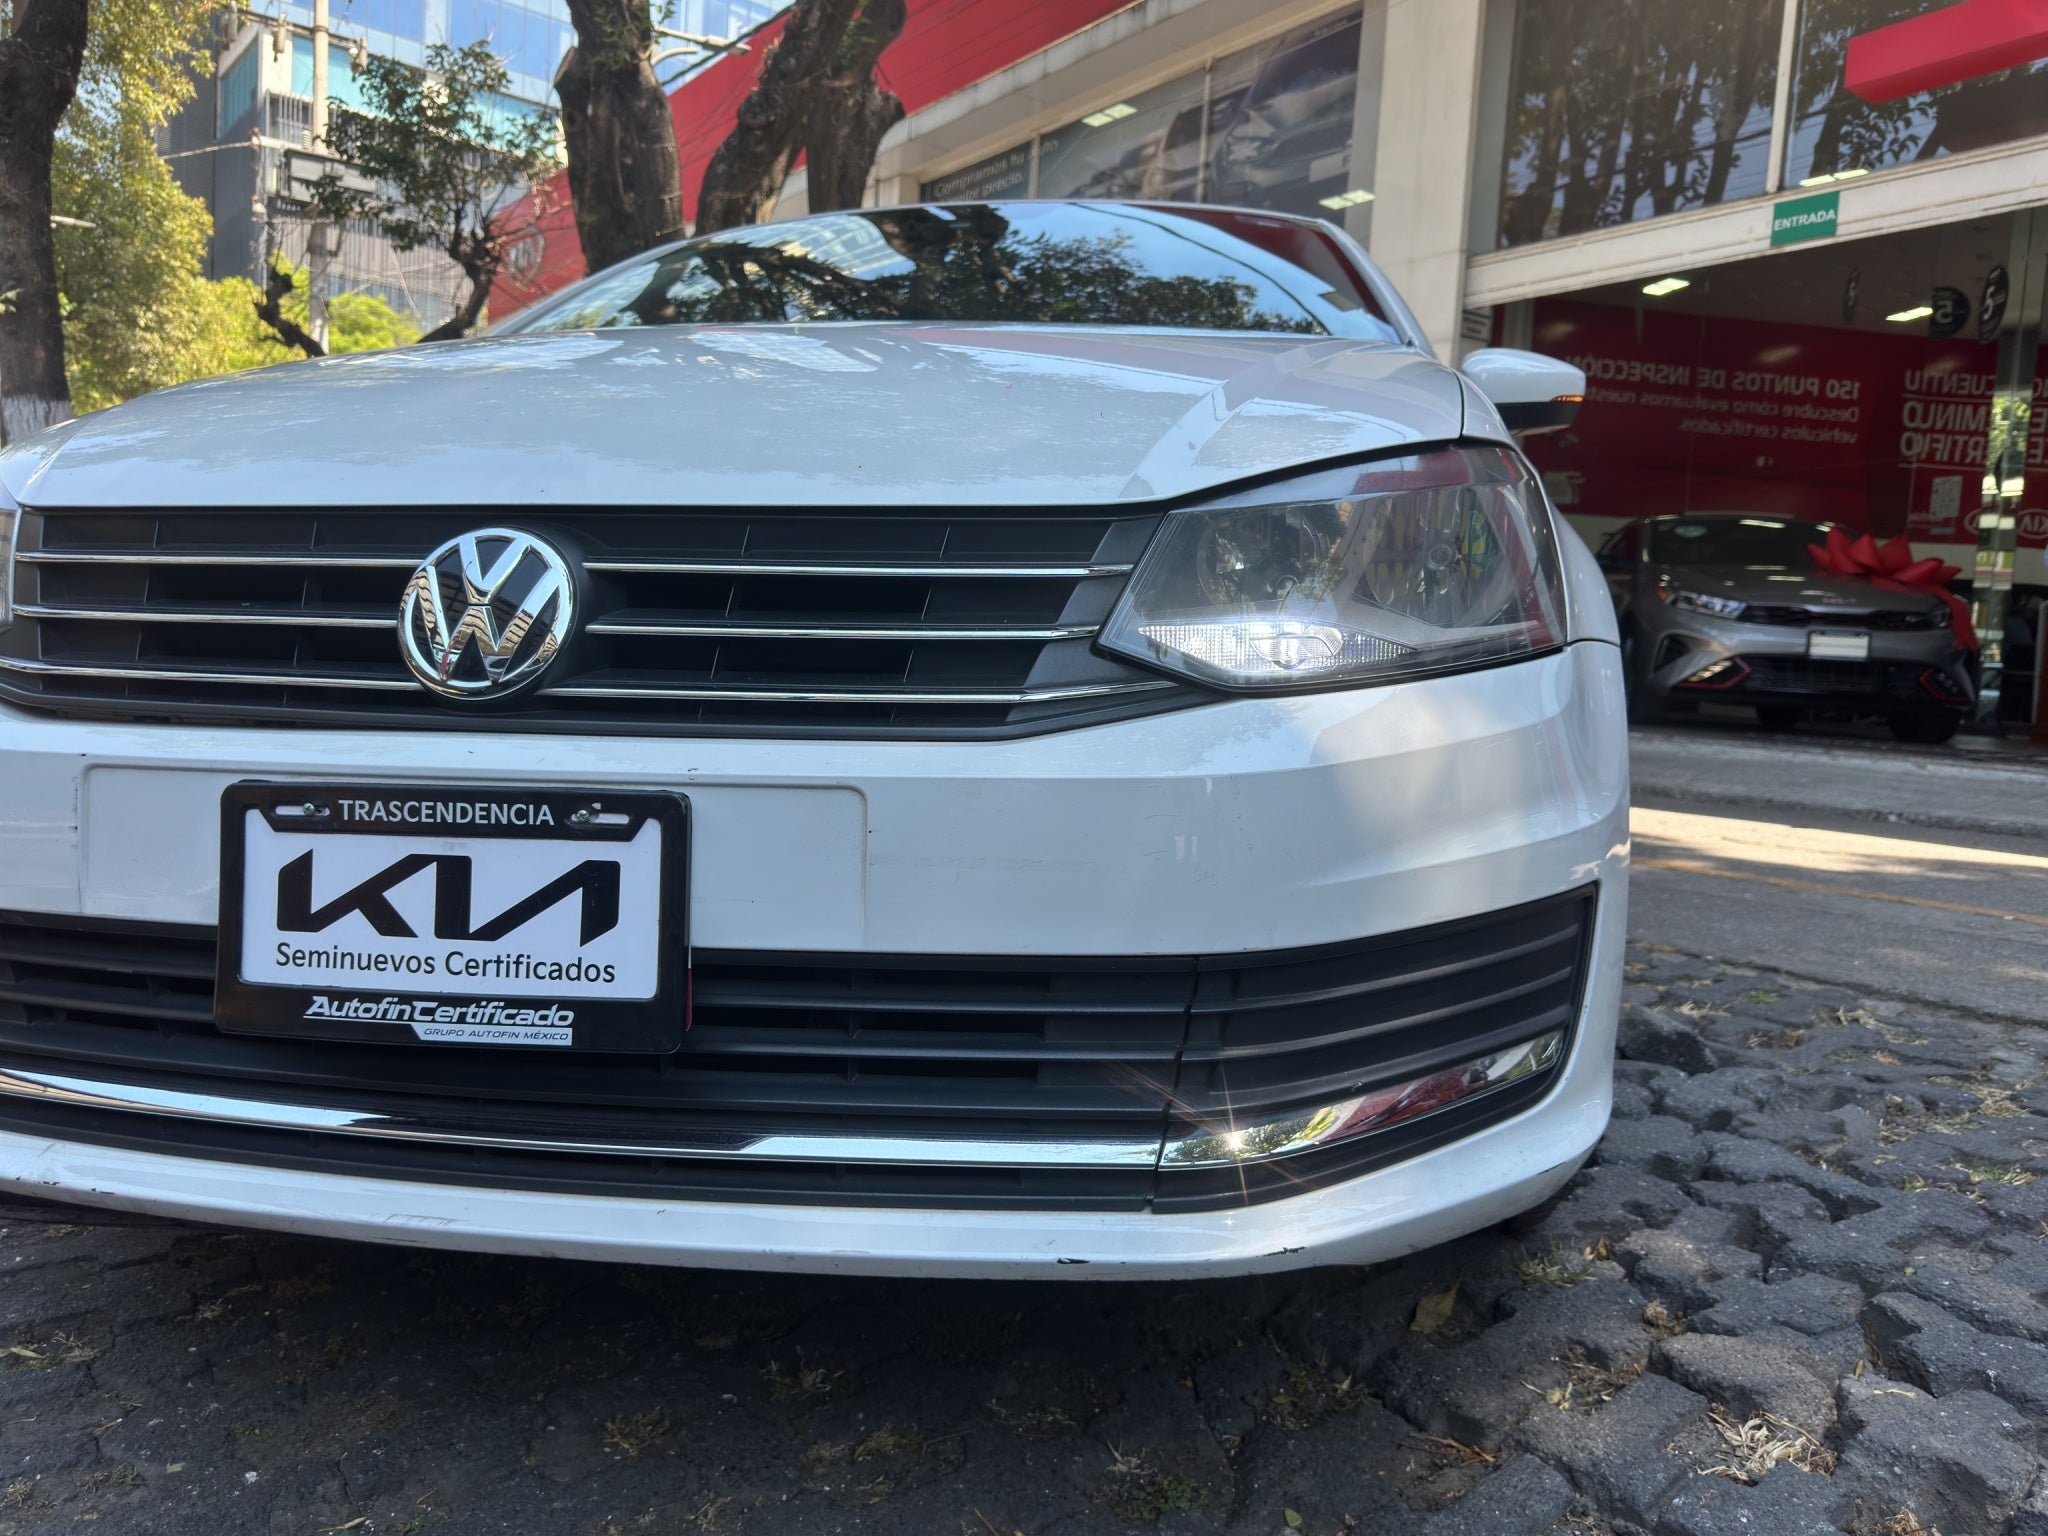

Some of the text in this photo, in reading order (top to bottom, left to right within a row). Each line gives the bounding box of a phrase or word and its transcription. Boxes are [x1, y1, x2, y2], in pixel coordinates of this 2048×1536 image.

[1774, 208, 1837, 231] ENTRADA
[339, 799, 555, 826] TRASCENDENCIA
[277, 848, 621, 947] KIA
[276, 942, 616, 983] Seminuevos Certificados
[423, 1028, 569, 1041] GRUPO AUTOFIN MÉXICO
